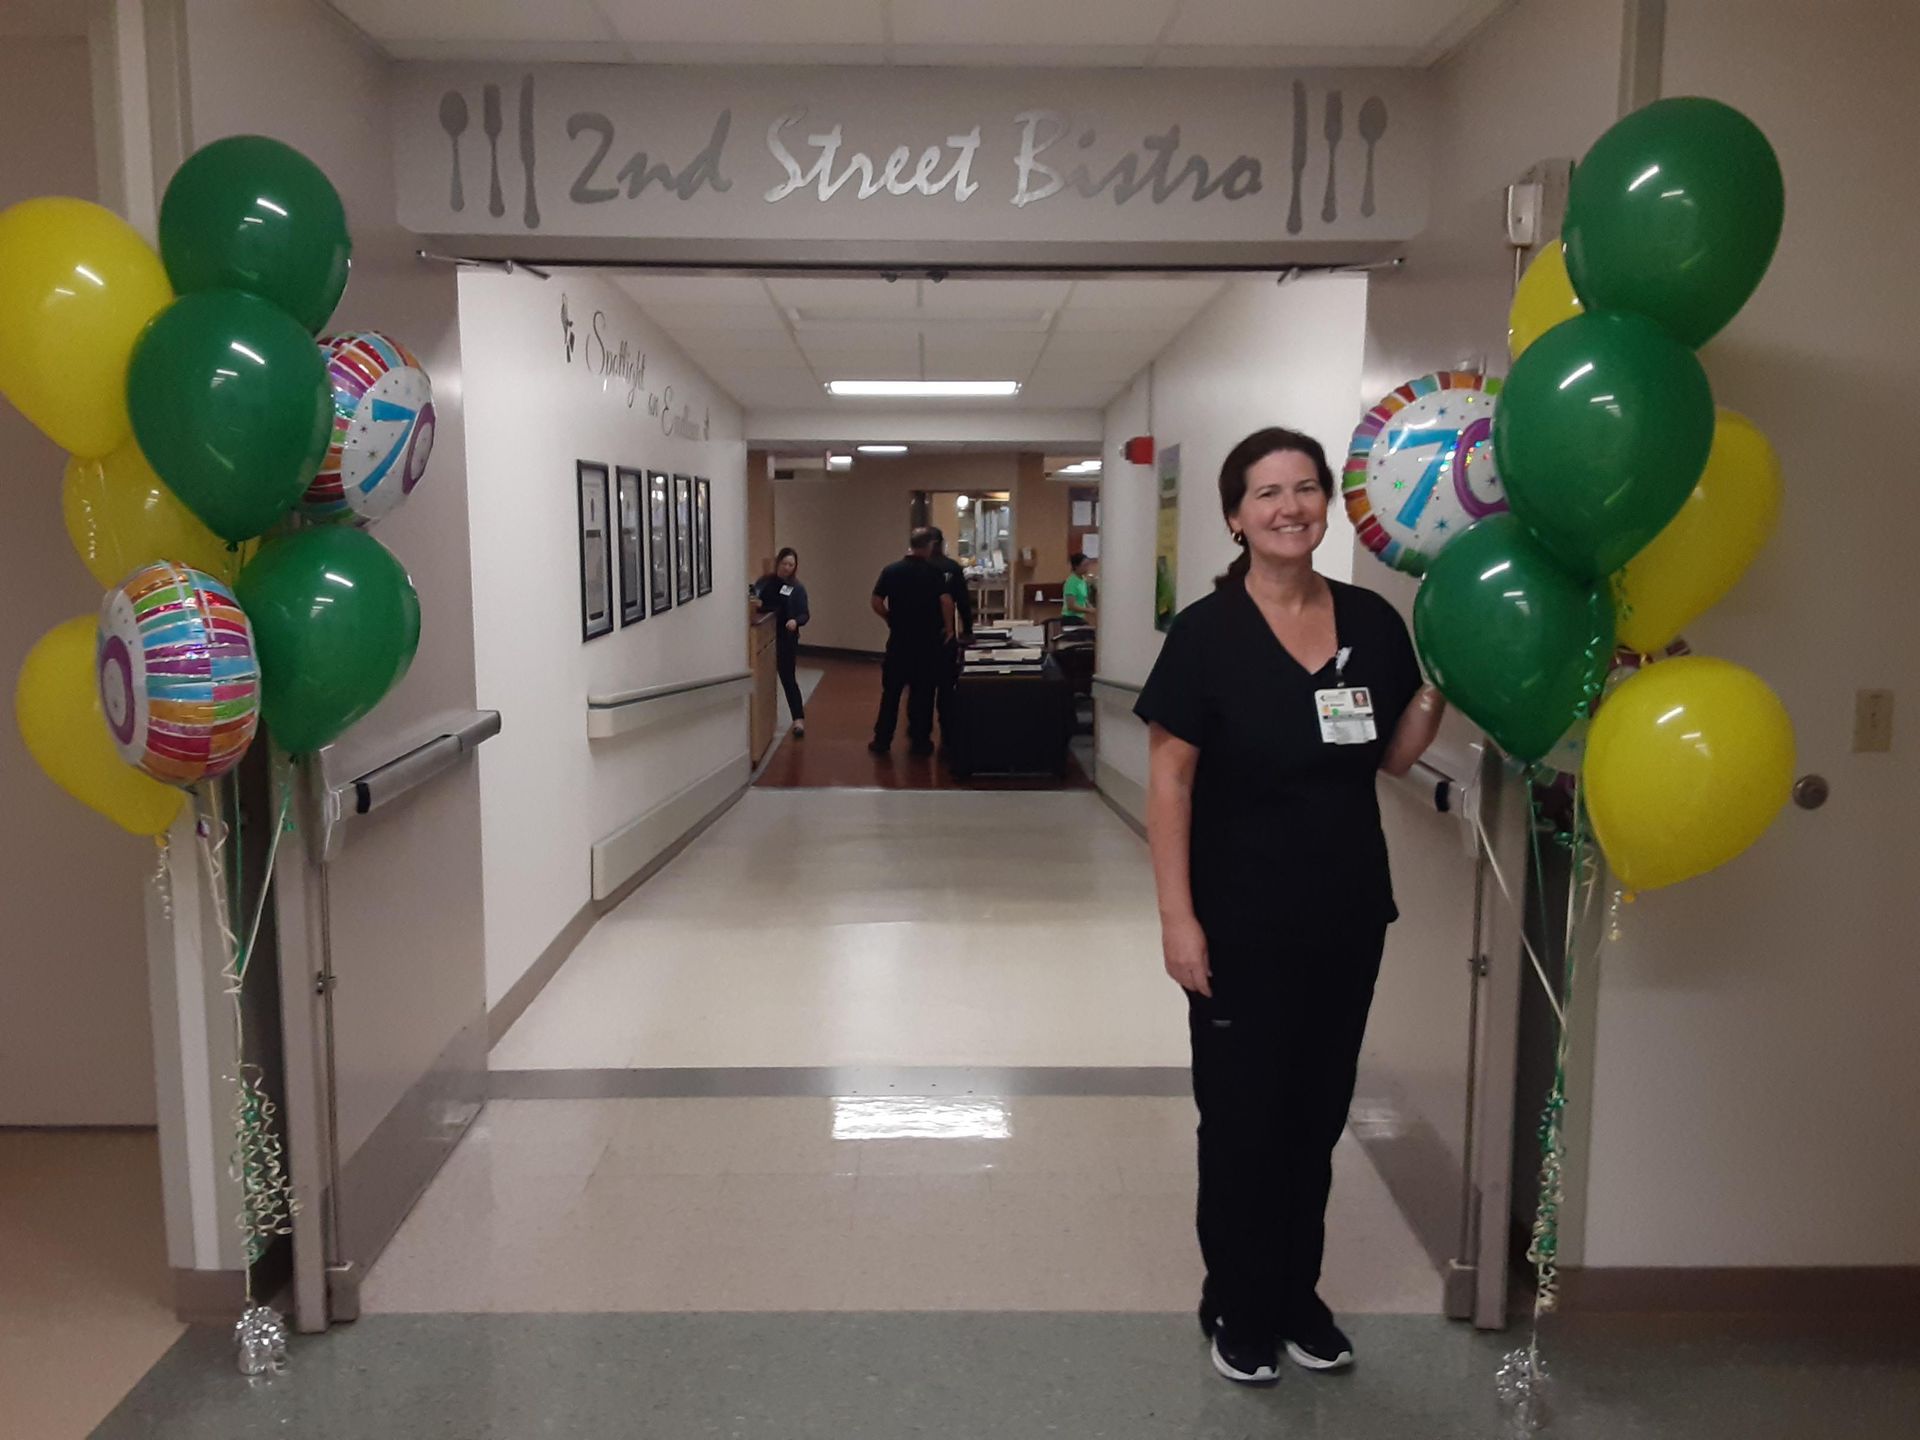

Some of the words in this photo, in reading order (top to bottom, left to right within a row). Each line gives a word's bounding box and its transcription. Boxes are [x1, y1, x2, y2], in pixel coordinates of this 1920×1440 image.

[565, 110, 733, 205] 2nd
[764, 102, 983, 204] Street
[1012, 109, 1263, 208] Bistro
[585, 310, 646, 409] Spotlight
[359, 398, 436, 495] 70
